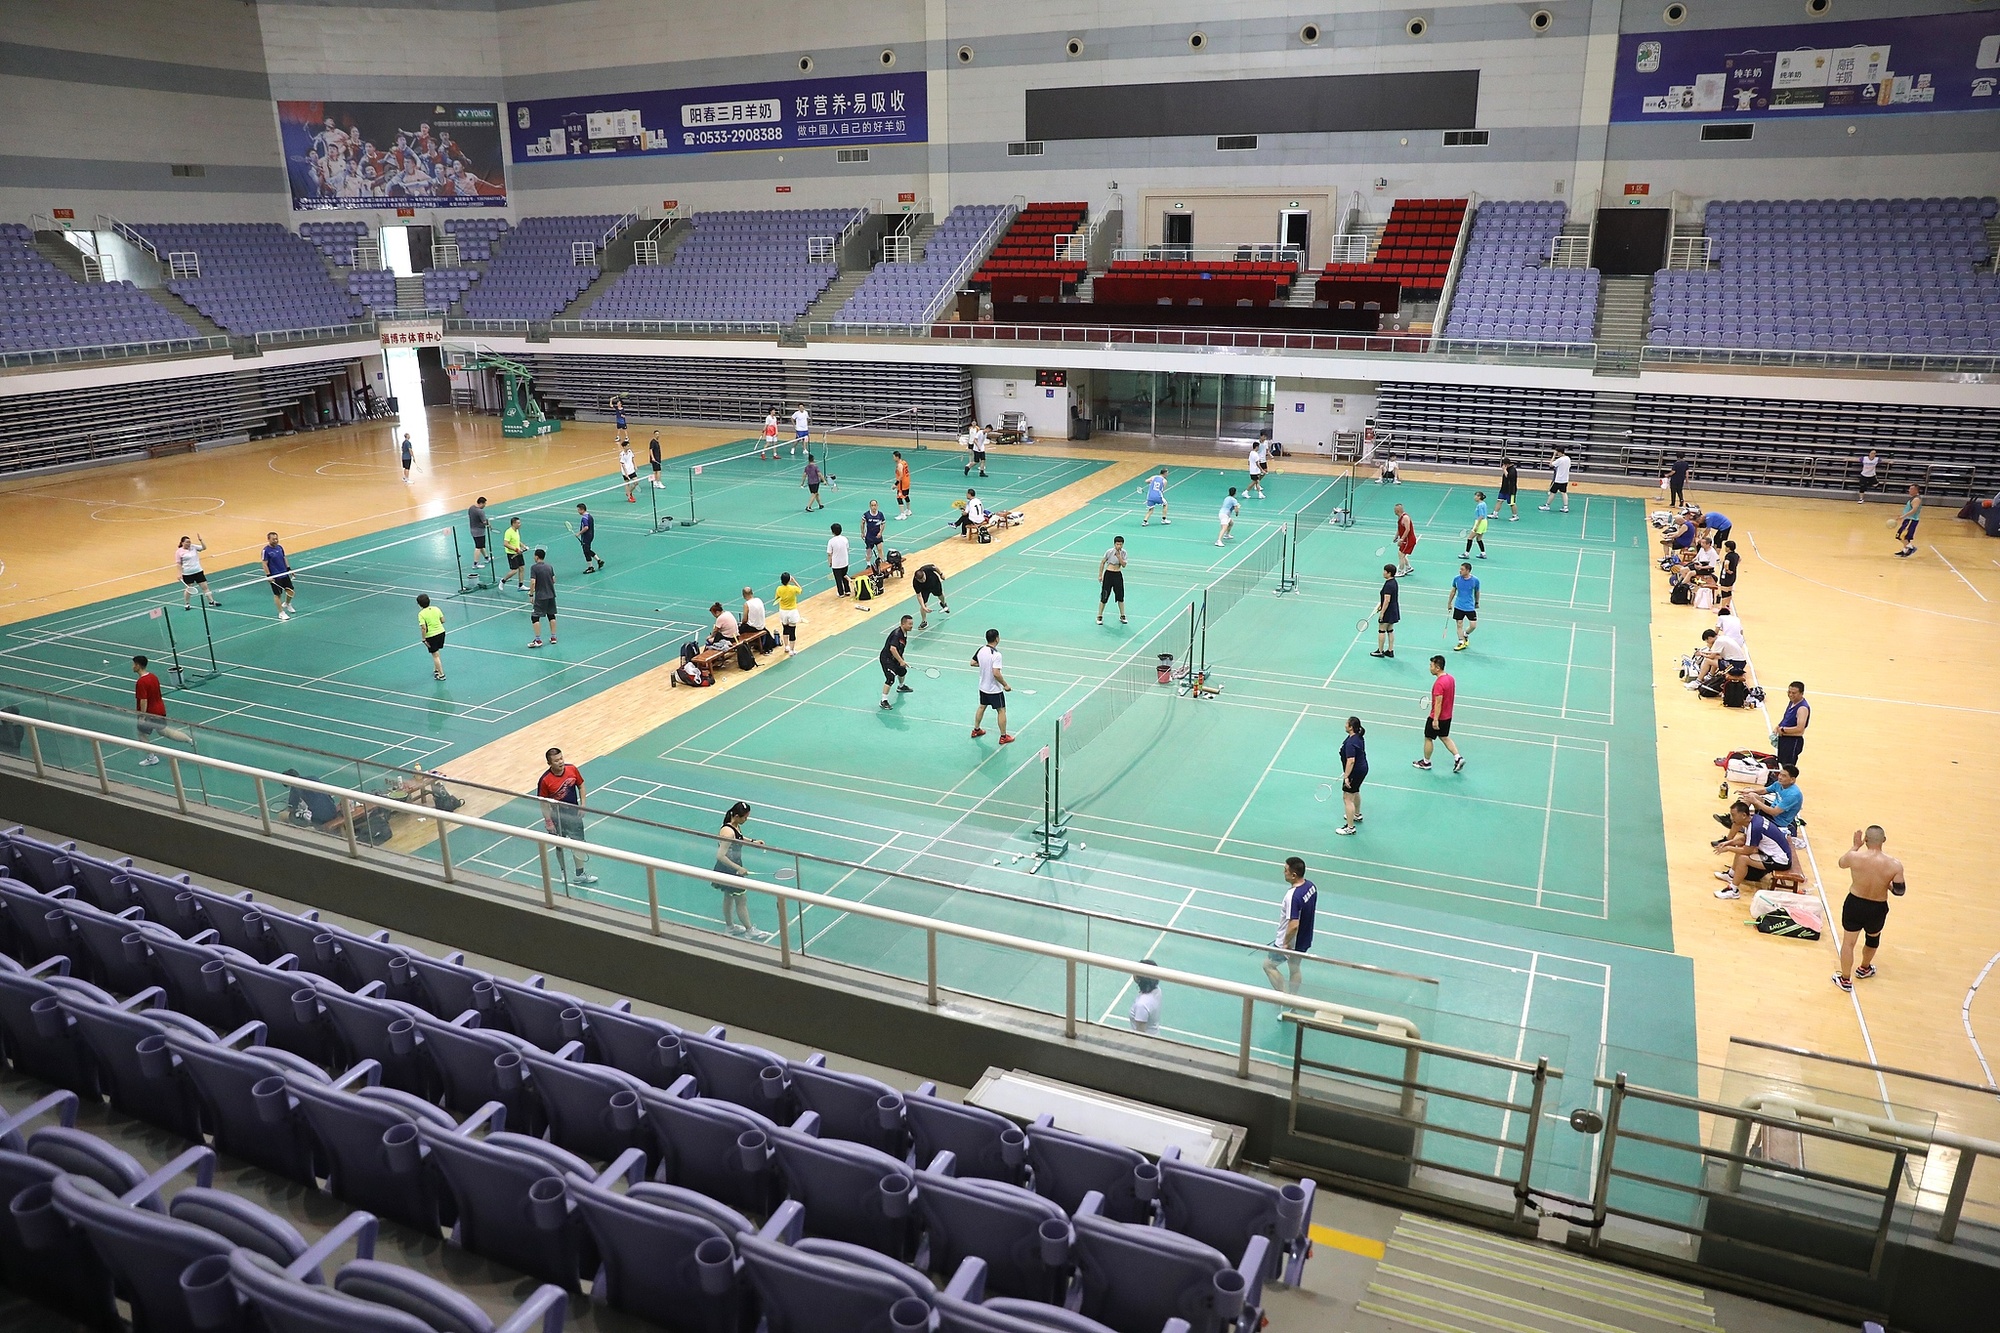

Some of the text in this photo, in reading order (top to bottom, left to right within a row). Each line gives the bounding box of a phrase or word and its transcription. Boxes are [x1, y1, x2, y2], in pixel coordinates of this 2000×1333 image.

[1734, 68, 1762, 78] 纯羊奶
[1780, 71, 1802, 79] 纯羊奶
[1835, 71, 1853, 83] 羊奶
[470, 109, 491, 117] YONEX
[689, 103, 772, 123] 阳春三月羊奶
[797, 120, 906, 137] 做中国人自己的好羊奶
[381, 331, 443, 344] 淄博市体育中心
